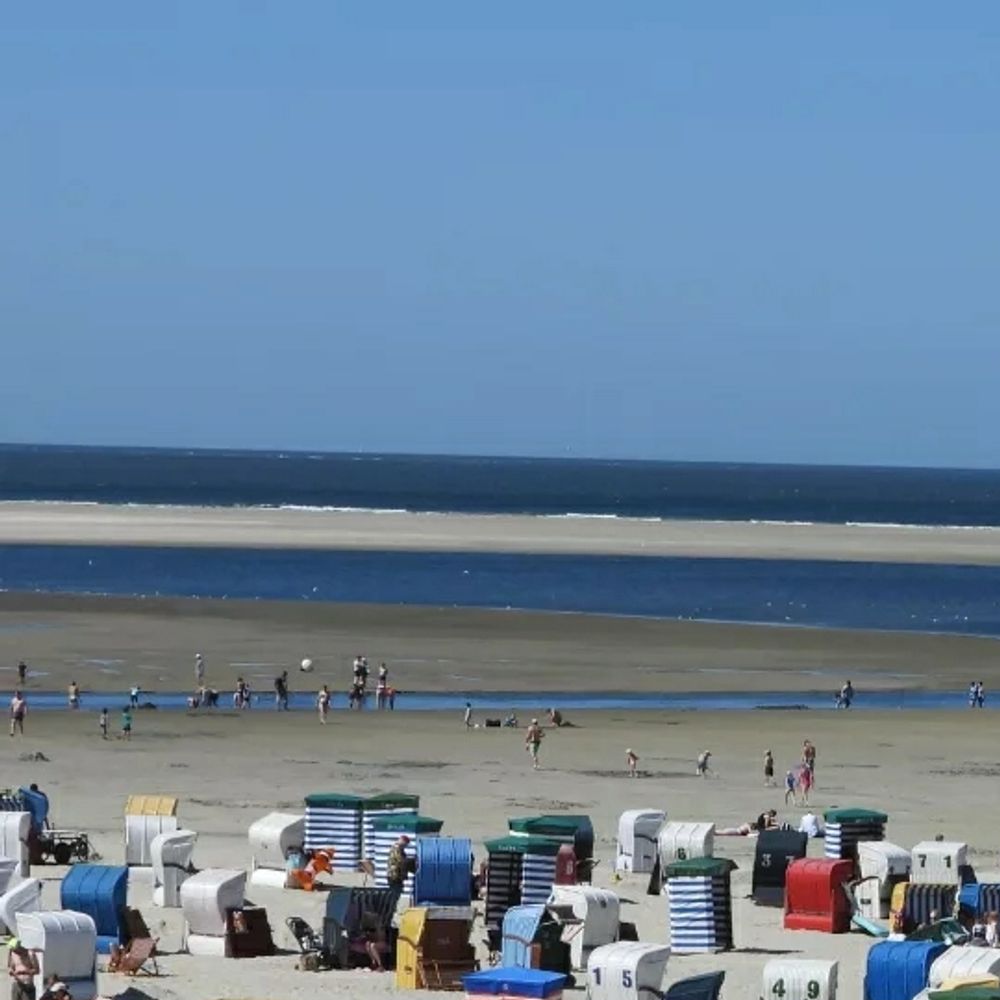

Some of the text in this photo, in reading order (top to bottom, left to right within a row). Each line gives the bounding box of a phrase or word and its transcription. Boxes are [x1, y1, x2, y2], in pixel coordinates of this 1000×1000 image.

[918, 853, 952, 868] 7 1
[592, 966, 633, 988] 1 5
[772, 978, 820, 999] 4 9
